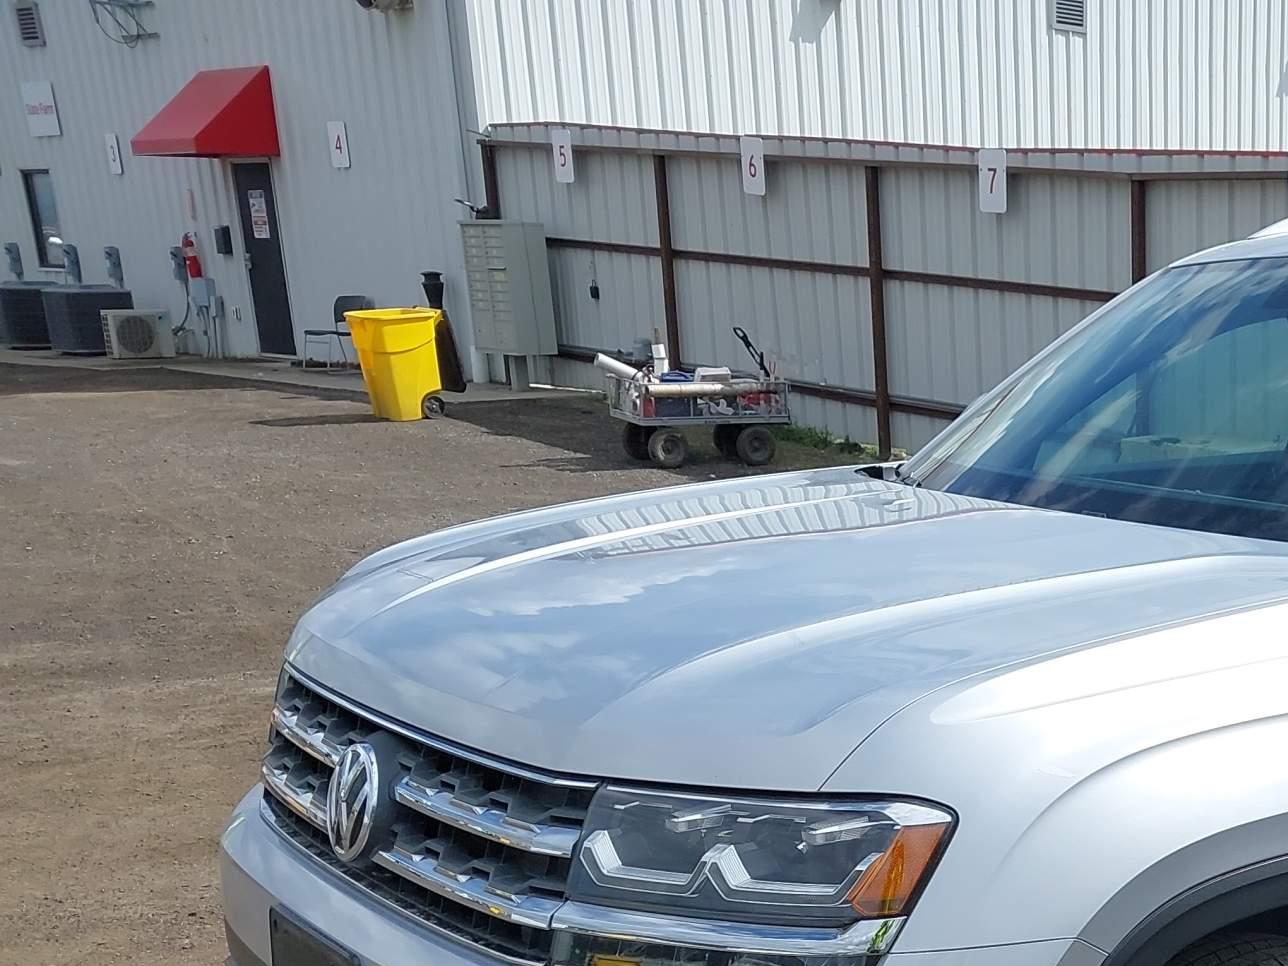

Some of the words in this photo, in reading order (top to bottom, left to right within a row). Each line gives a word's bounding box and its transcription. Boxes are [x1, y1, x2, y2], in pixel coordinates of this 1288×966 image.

[335, 134, 343, 155] 4
[559, 145, 567, 168] 5
[749, 154, 757, 178] 6
[987, 167, 998, 194] 7
